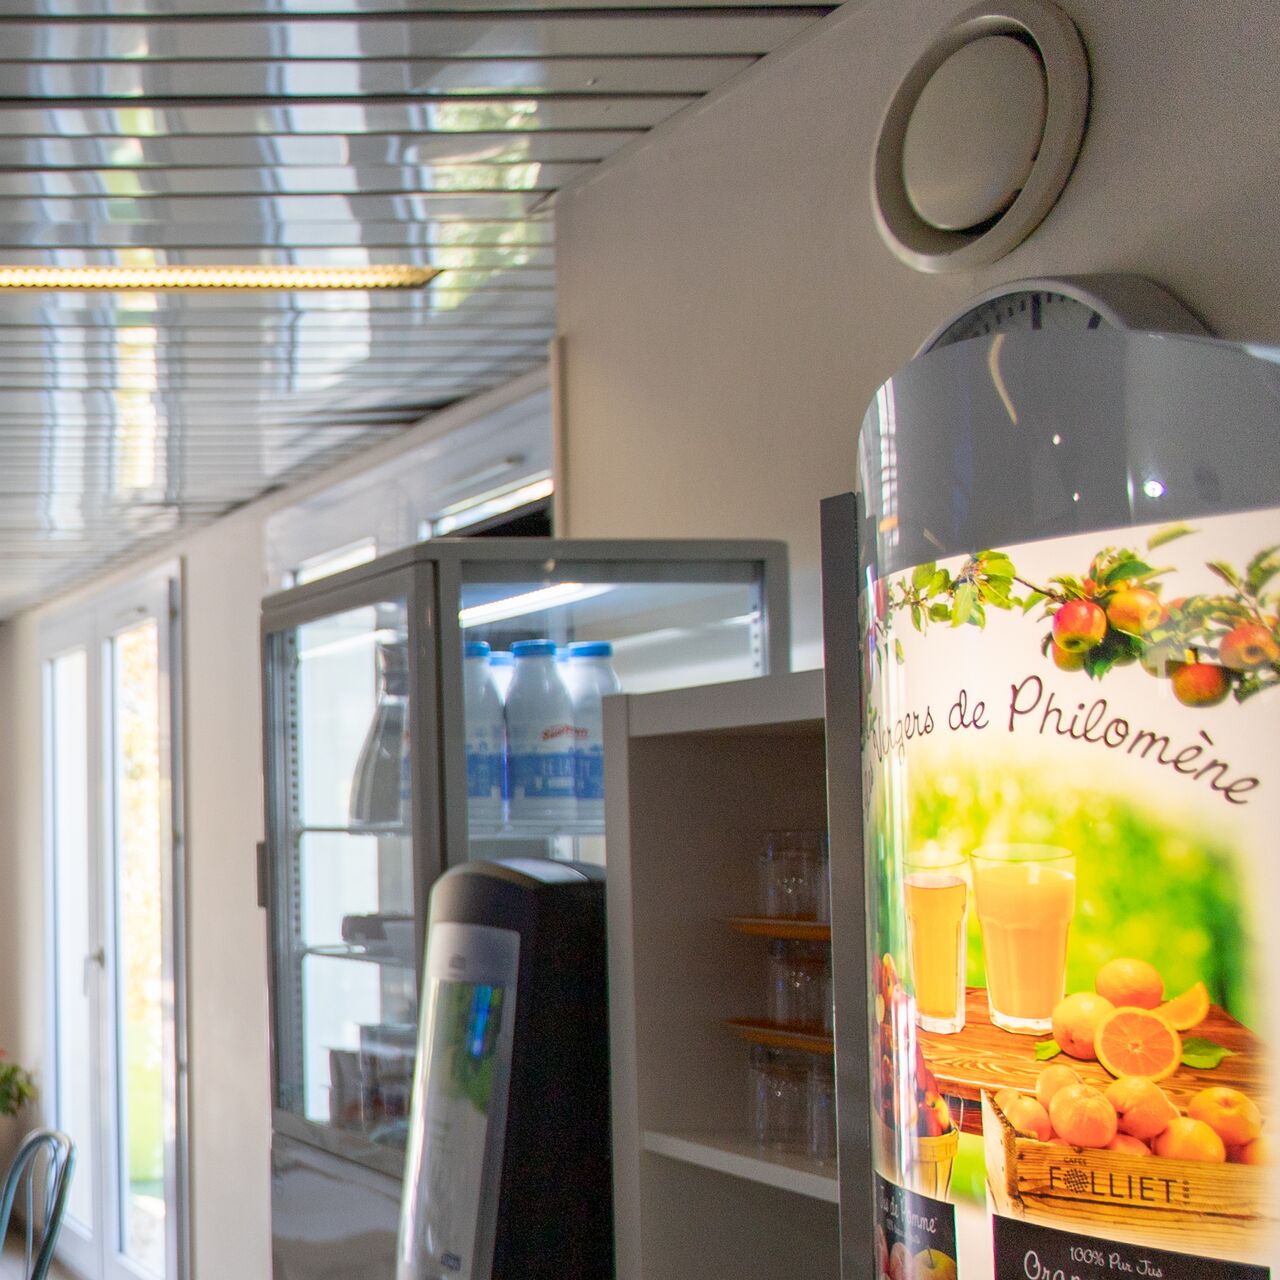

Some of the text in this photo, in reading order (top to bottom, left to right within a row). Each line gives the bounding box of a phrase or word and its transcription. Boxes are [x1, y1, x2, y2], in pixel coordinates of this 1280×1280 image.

[948, 688, 990, 731] de
[1007, 674, 1262, 805] Philomène
[1069, 1247, 1164, 1279] 100% Pur Jus
